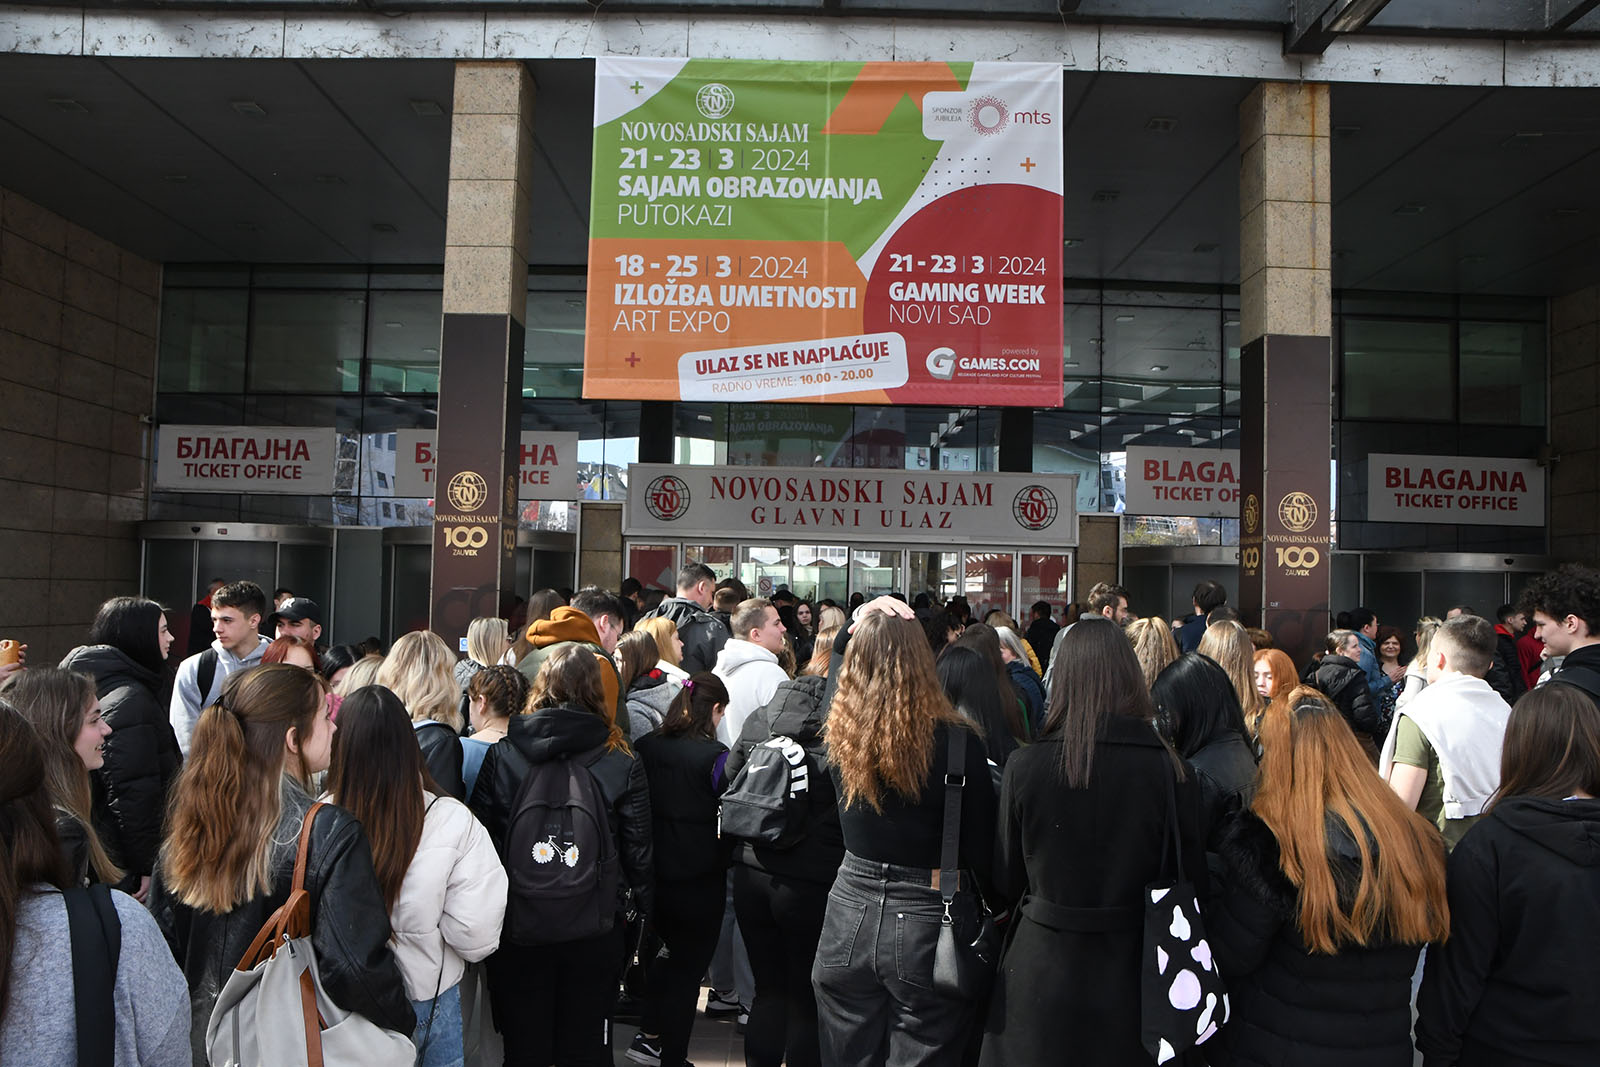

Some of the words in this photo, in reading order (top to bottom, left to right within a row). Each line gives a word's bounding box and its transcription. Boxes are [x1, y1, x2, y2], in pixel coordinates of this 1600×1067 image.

[1014, 110, 1051, 124] mts
[620, 122, 742, 142] NOVOSADSKI
[746, 123, 809, 142] SAJAM
[619, 148, 648, 168] 21
[668, 148, 700, 170] 23
[718, 148, 734, 170] 3
[751, 149, 810, 171] 2024
[618, 175, 700, 202] SAJAM
[706, 176, 882, 205] OBRAZOVANJA
[618, 204, 732, 226] PUTOKAZI
[615, 254, 644, 276] 18
[666, 255, 698, 277] 25
[715, 255, 731, 277] 3
[749, 256, 808, 279] 2024
[888, 254, 913, 272] 21
[930, 254, 956, 273] 23
[971, 255, 984, 274] 3
[999, 256, 1046, 276] 2024
[614, 278, 714, 306] IZLOŽBA
[720, 285, 856, 308] UMETNOSTI
[889, 281, 979, 302] GAMING
[984, 284, 1046, 304] WEEK
[613, 310, 661, 332] ART
[669, 310, 730, 333] EXPO
[889, 304, 941, 324] NOVI
[948, 305, 991, 326] SAD
[696, 356, 740, 375] ULAZ
[744, 354, 763, 370] SE
[767, 352, 789, 368] NE
[794, 339, 889, 365] NAPLAĆUJE
[959, 358, 1040, 371] GAMES.CON
[712, 381, 752, 393] RADNO
[756, 376, 797, 389] VREME:
[800, 372, 831, 385] 10.00
[840, 368, 874, 381] 20.00
[177, 437, 311, 461] БЛАГАЈНА
[184, 463, 241, 478] TICKET
[244, 464, 302, 479] OFFICE
[1144, 459, 1240, 484] BLAGA
[1385, 467, 1527, 492] BLAGAJNA
[710, 476, 884, 503] NOVOSADSKI
[903, 480, 993, 506] SAJAM
[1152, 486, 1214, 502] TICKET
[1394, 493, 1454, 508] TICKET
[1458, 495, 1518, 511] OFFICE
[435, 515, 475, 523] NOVOSADSKI
[751, 506, 860, 526] GLAVNI
[880, 510, 952, 528] ULAZ
[444, 526, 488, 548] 100
[1267, 535, 1307, 543] NOVOSADSKI
[1276, 546, 1320, 568] 100
